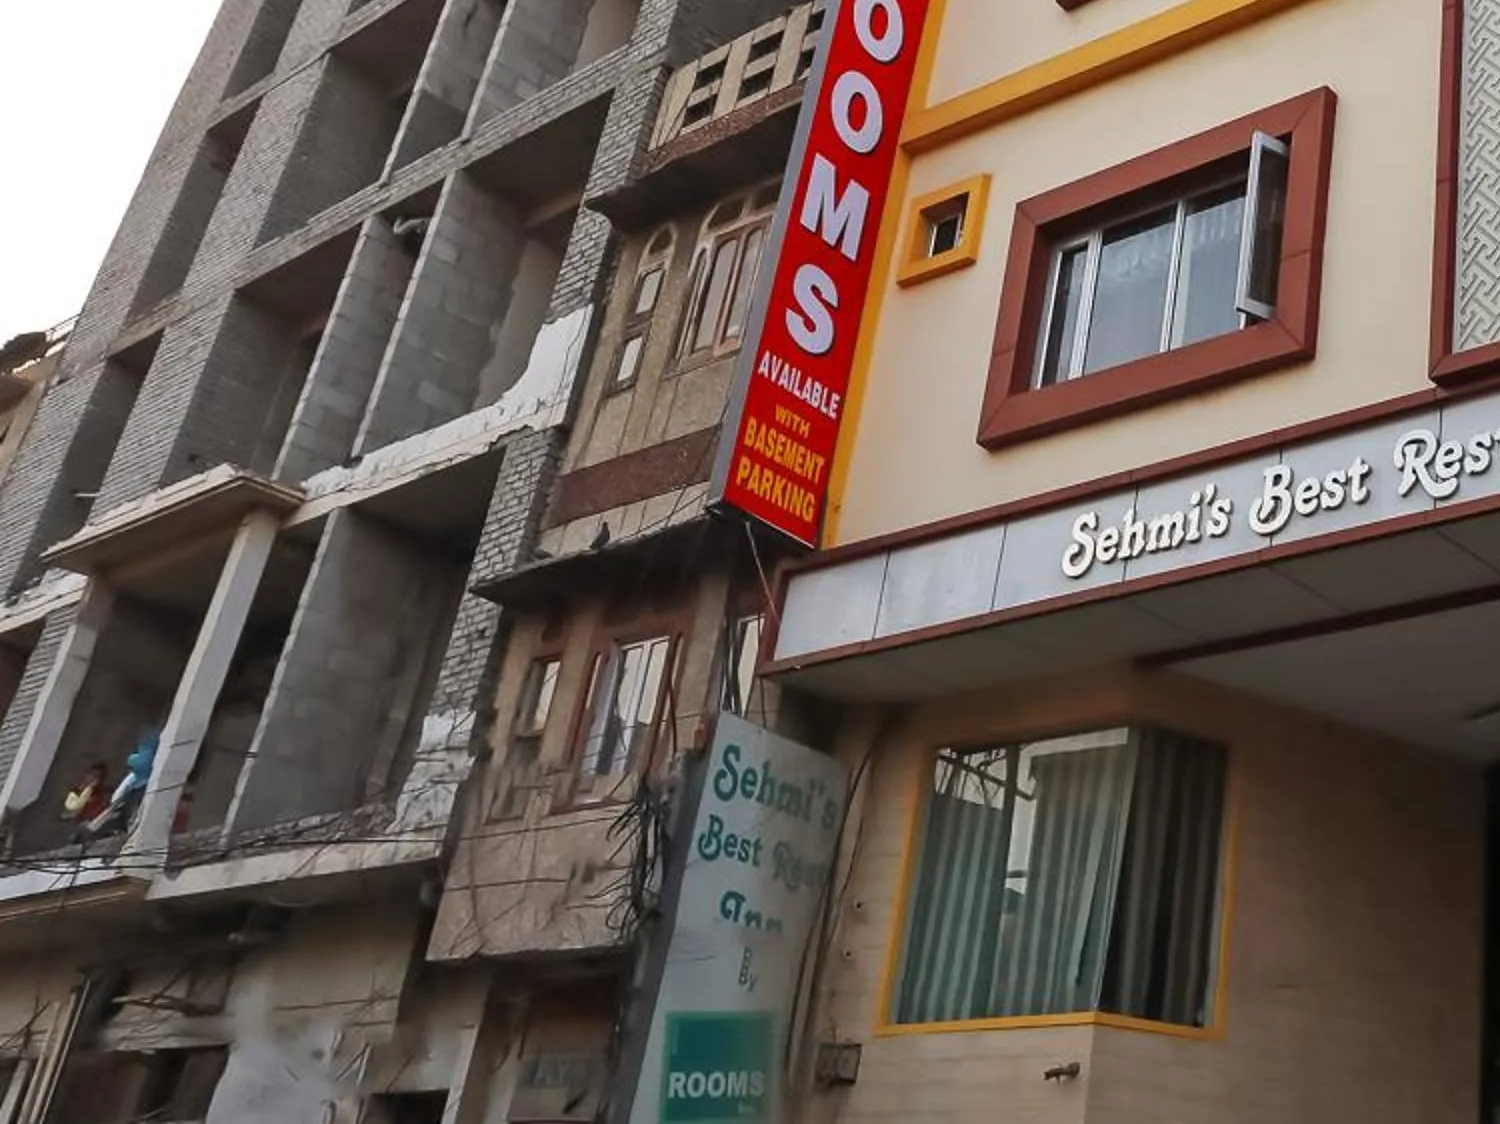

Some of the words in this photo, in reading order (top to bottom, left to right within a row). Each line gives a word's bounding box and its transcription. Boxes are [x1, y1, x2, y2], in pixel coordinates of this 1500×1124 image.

[757, 349, 842, 420] AVAILABLE
[743, 417, 826, 484] BASEMENT
[775, 403, 811, 439] WITH
[736, 455, 816, 523] PARKING
[1061, 483, 1233, 578] Sehmi's
[1248, 462, 1371, 536] Best
[713, 744, 838, 831] Sehmi's
[697, 813, 764, 868] Best
[667, 1070, 766, 1100] ROOMS
